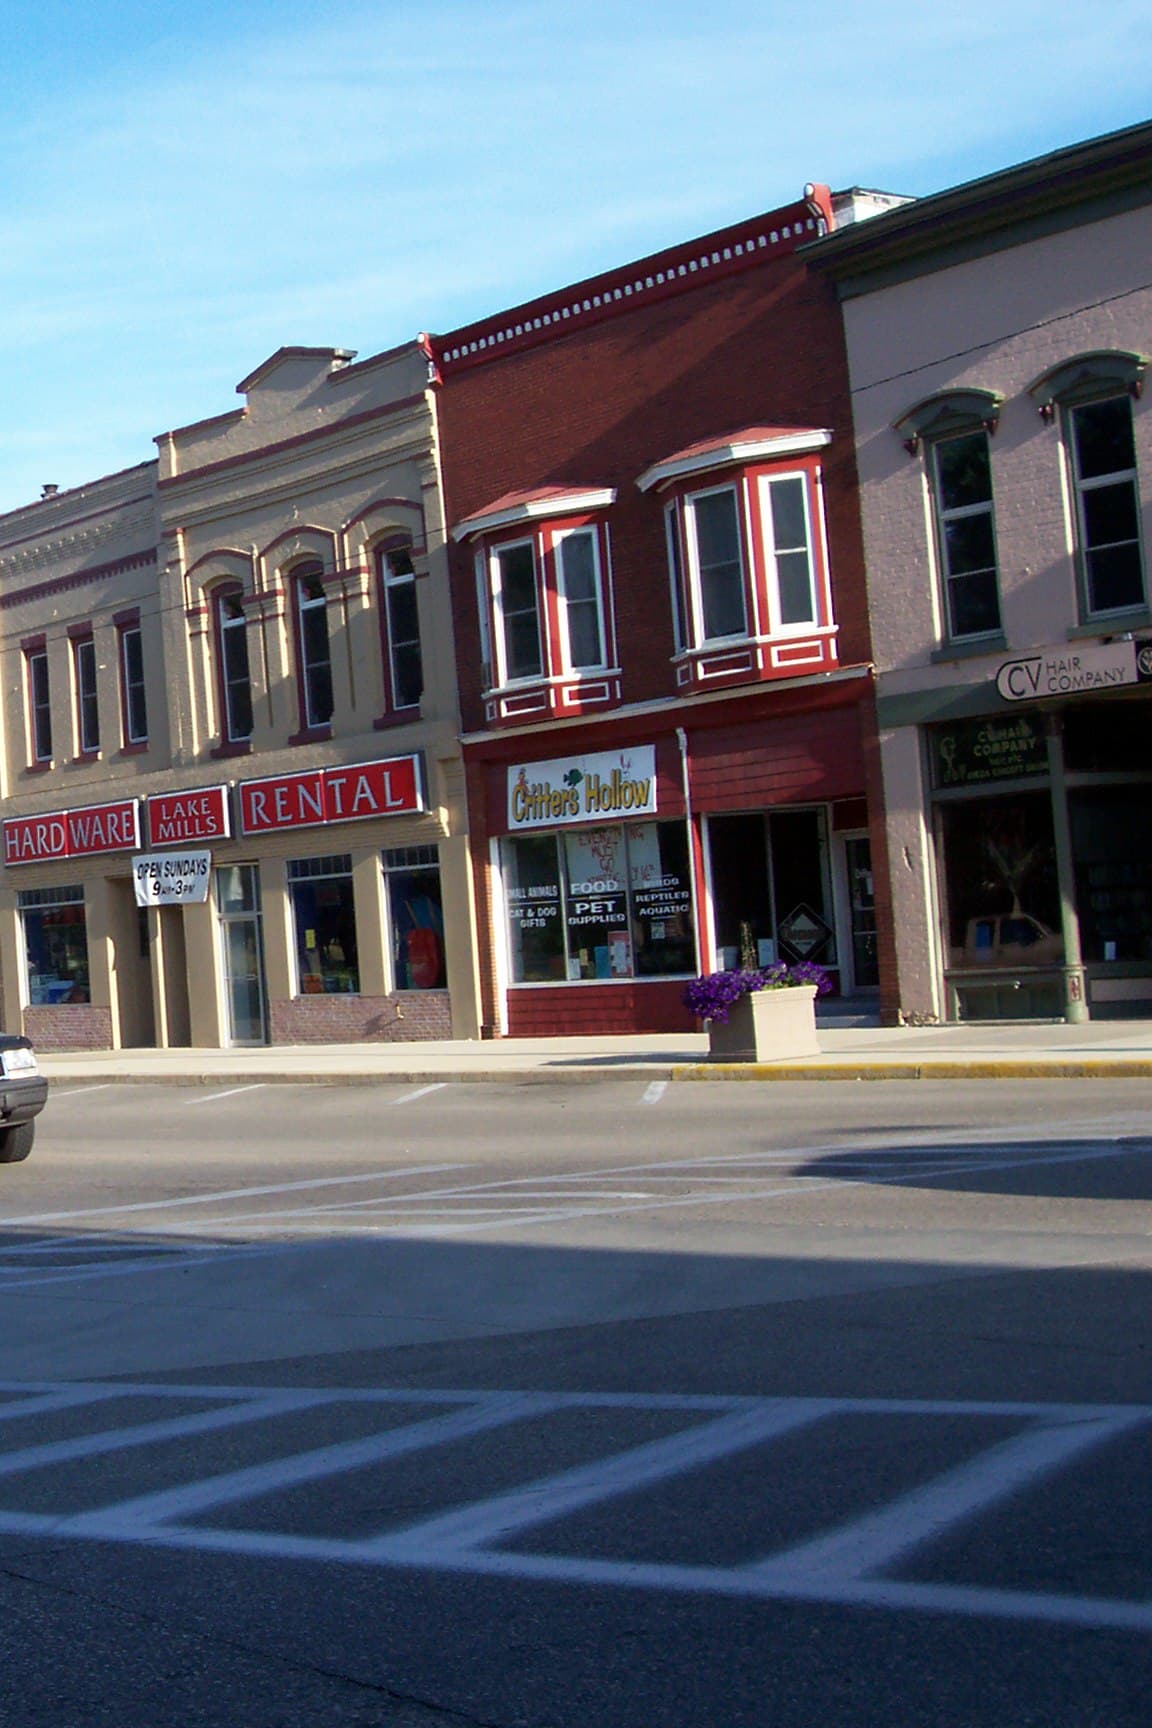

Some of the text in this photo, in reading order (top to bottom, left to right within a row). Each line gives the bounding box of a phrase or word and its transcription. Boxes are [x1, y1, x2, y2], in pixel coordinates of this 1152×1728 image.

[1046, 656, 1081, 676] HAIR
[1007, 663, 1042, 697] CV
[1048, 666, 1126, 692] COMPANY
[250, 771, 405, 826] RENTAL
[511, 768, 651, 823] Critters Hollow
[161, 797, 212, 821] LAKE
[158, 815, 218, 840] MILLS
[137, 857, 208, 880] OPEN SUNDAYS
[570, 879, 619, 895] FOOD
[635, 890, 690, 903] REPTILES
[527, 908, 535, 918] &
[537, 906, 557, 917] DOG
[575, 900, 617, 914] PET
[519, 917, 547, 929] GIFTS
[567, 913, 626, 926] SUPPLIES
